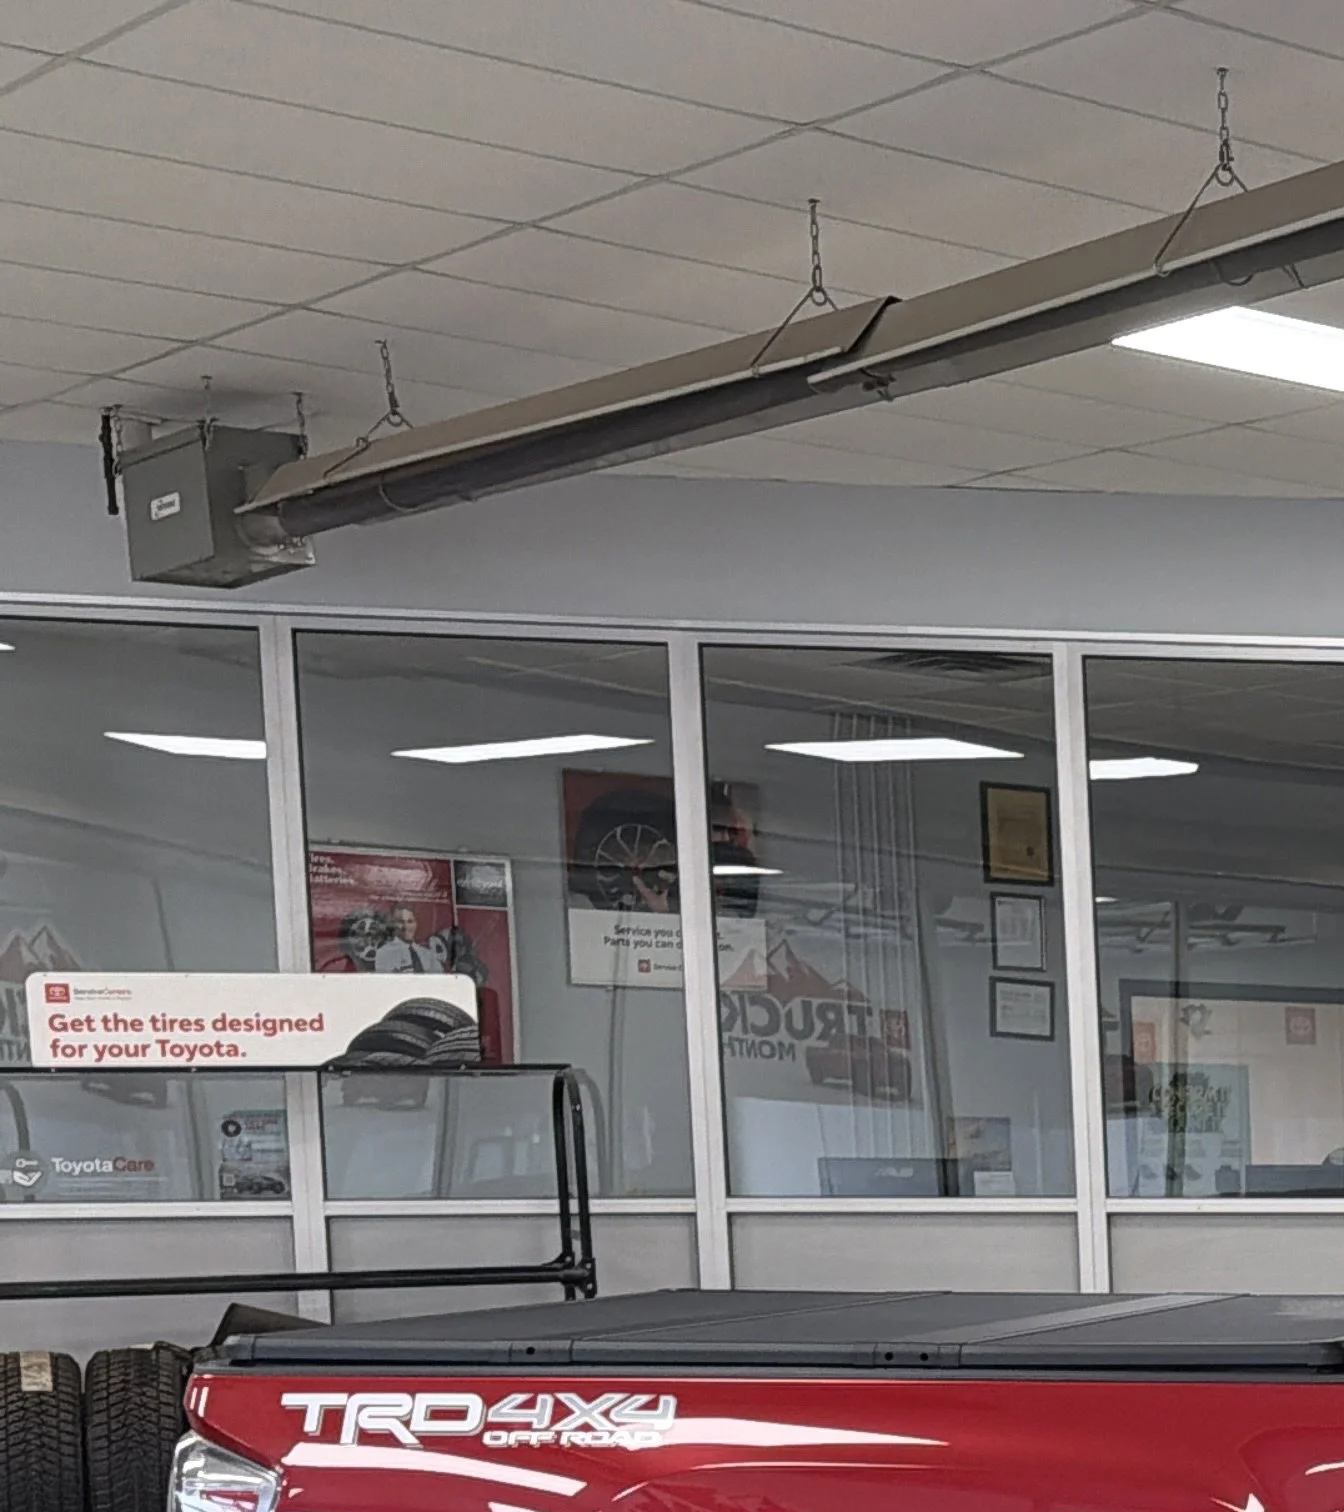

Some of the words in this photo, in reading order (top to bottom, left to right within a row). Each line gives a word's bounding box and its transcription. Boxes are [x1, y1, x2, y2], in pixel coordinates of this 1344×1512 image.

[614, 924, 652, 937] Service
[654, 928, 673, 939] you
[603, 935, 630, 947] Parts
[633, 939, 652, 950] you
[655, 940, 674, 949] can
[48, 1013, 96, 1033] Get
[101, 1012, 144, 1033] the
[149, 1012, 206, 1033] tires
[212, 1012, 325, 1037] designed
[49, 1038, 88, 1059] for
[94, 1042, 151, 1063] your
[155, 1039, 248, 1063] Toyota.
[51, 1156, 155, 1176] ToyotaCare
[281, 1392, 487, 1447] TRD
[486, 1392, 679, 1431] 4X4
[482, 1430, 557, 1447] OFF
[559, 1431, 662, 1448] ROAD
